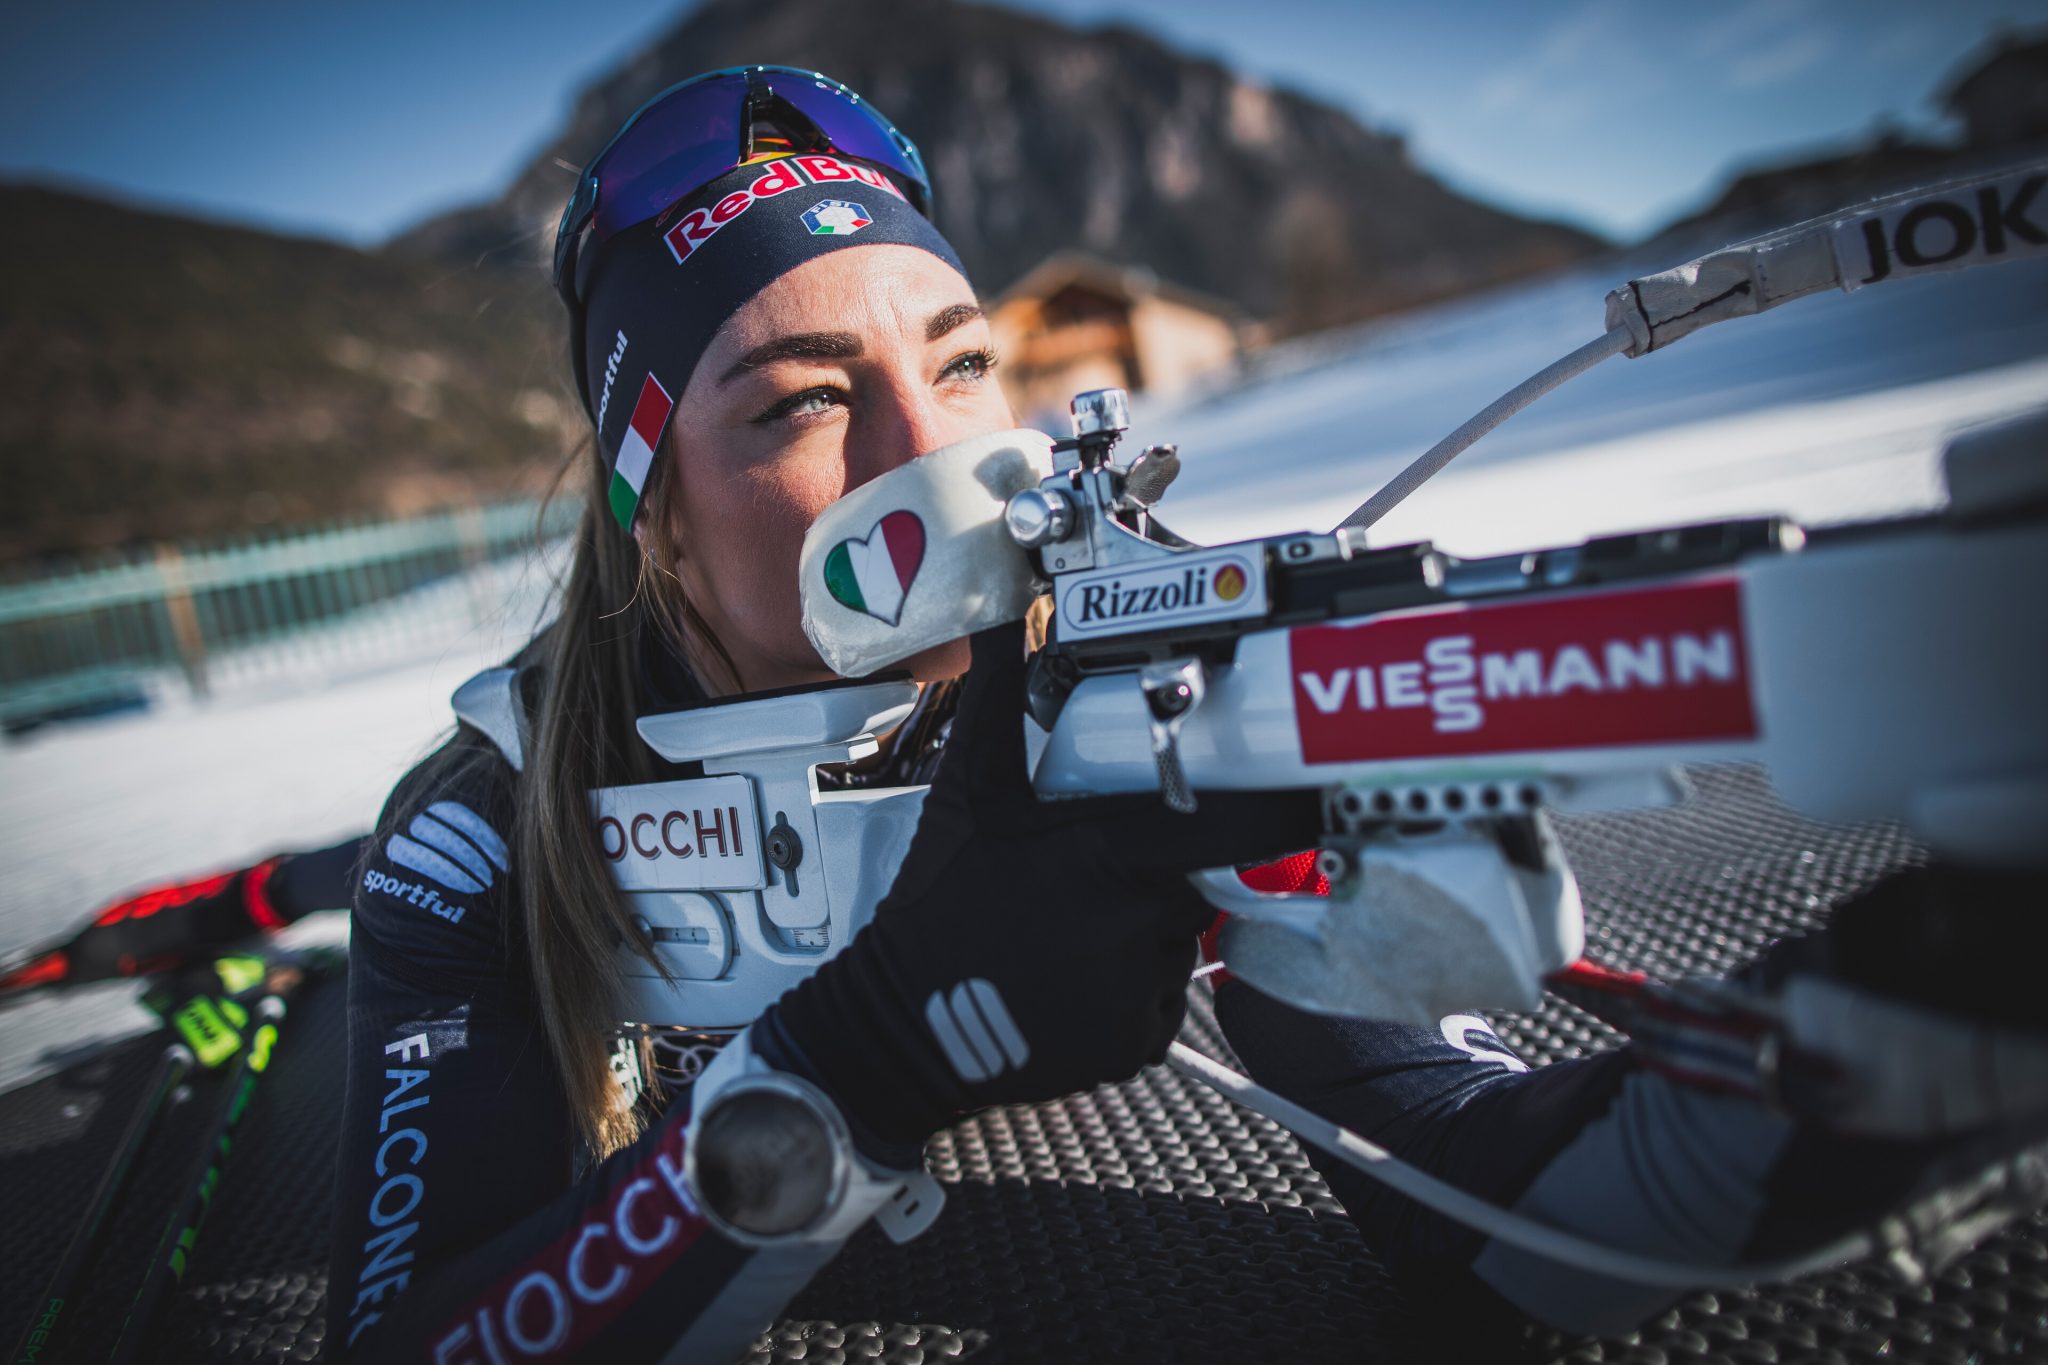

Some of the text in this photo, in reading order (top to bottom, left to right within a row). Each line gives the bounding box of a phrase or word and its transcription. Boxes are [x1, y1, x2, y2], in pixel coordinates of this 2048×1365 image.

[663, 160, 806, 266] Red
[598, 329, 629, 434] ortful
[1078, 567, 1207, 623] Rizzoli
[1299, 632, 1737, 732] VIESSMANN
[600, 806, 743, 863] OCCHI
[363, 869, 466, 924] sportful
[434, 1125, 700, 1365] FIOCCH
